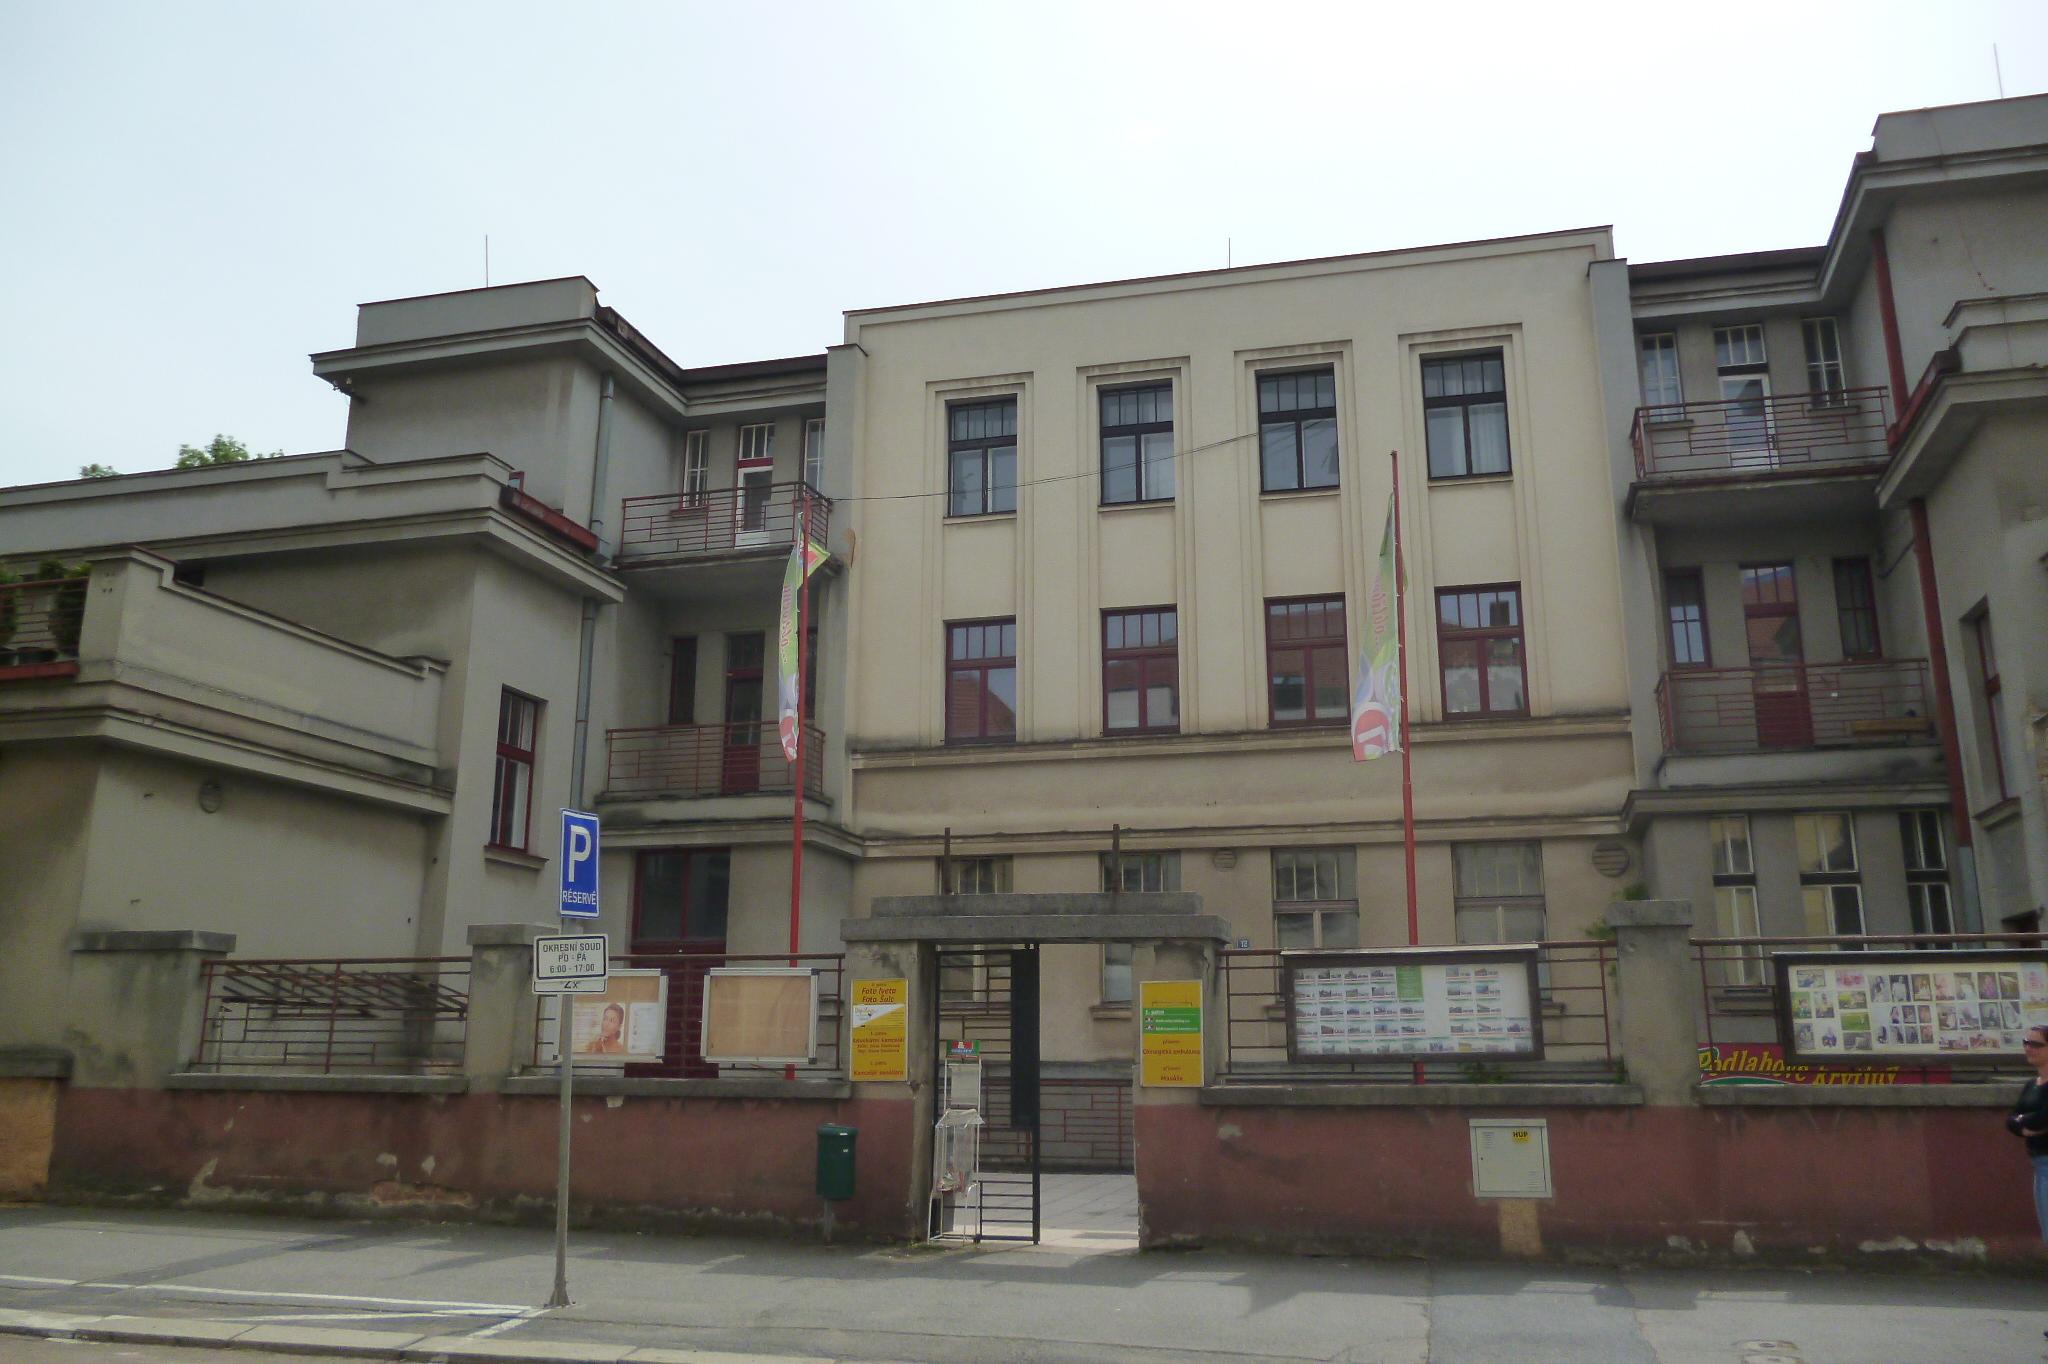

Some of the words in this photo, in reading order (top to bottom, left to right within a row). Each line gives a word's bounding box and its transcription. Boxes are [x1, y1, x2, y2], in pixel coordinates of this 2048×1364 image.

[568, 824, 592, 883] P
[562, 888, 597, 905] RÉSERVÉ
[542, 941, 578, 952] OKRESNÍ
[579, 942, 601, 951] SOUD
[558, 953, 569, 962] PO
